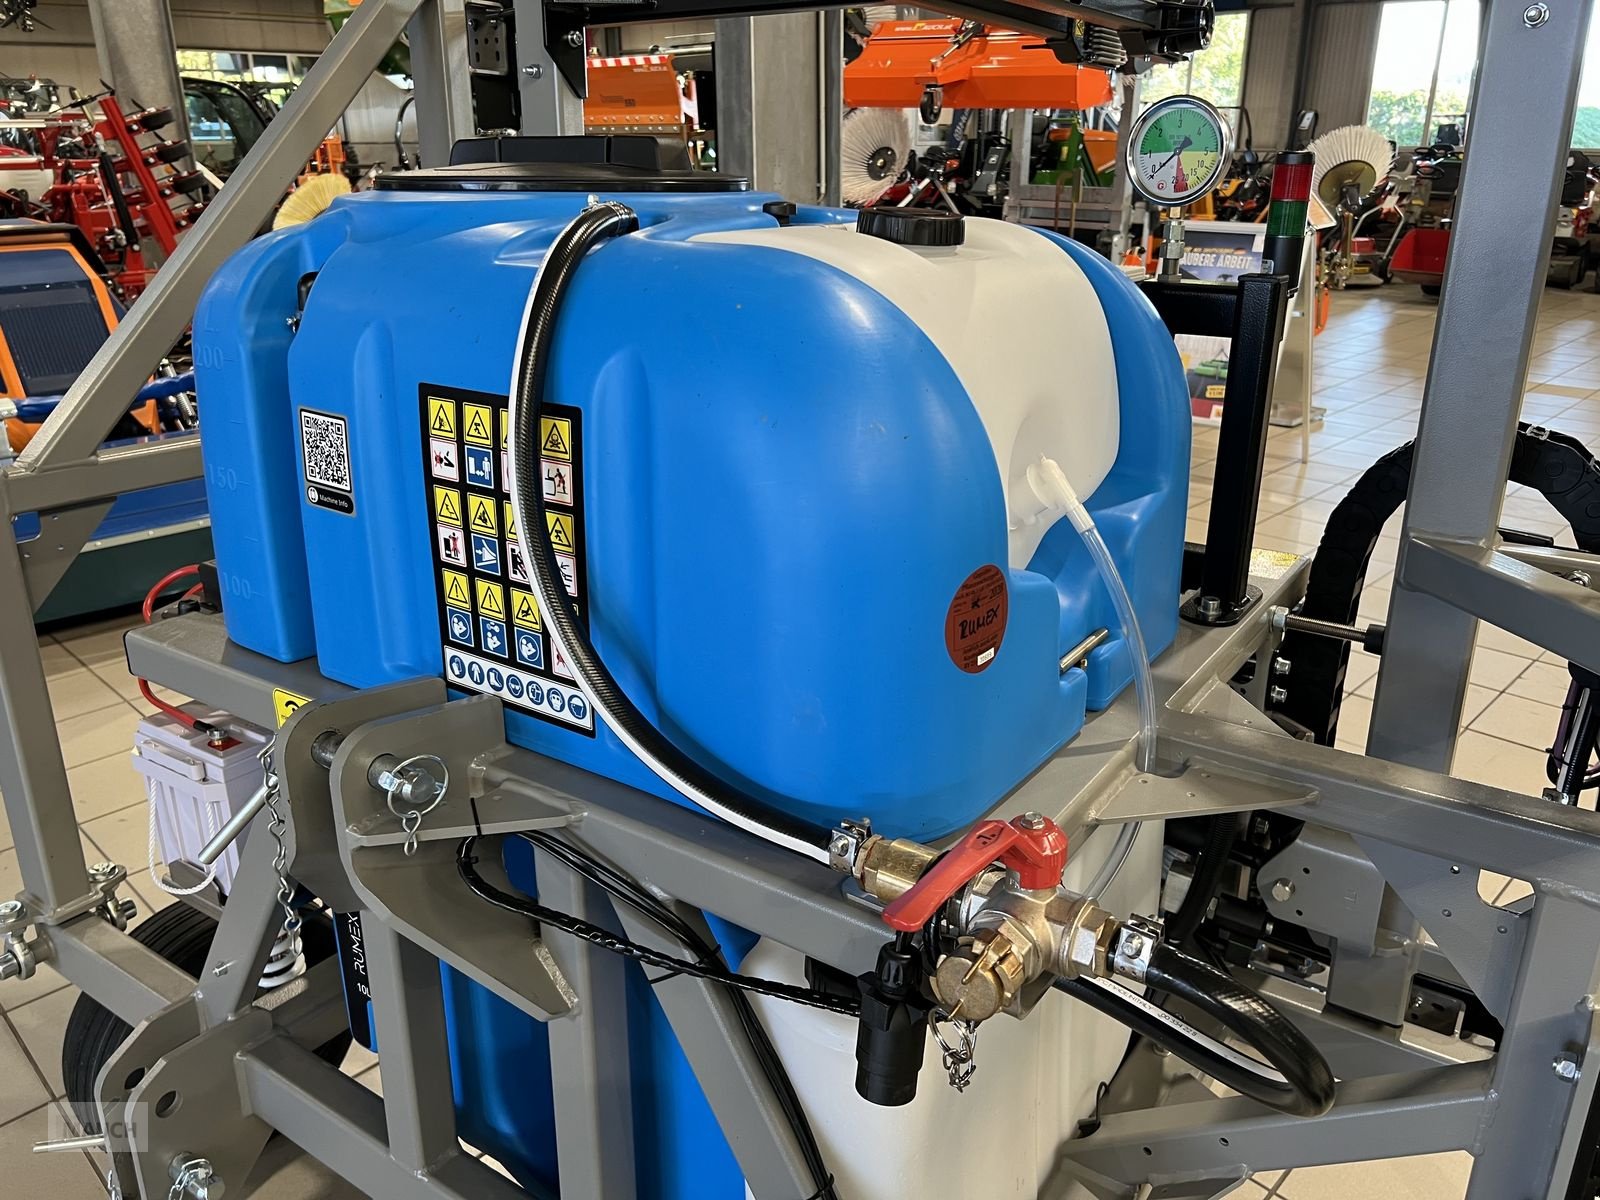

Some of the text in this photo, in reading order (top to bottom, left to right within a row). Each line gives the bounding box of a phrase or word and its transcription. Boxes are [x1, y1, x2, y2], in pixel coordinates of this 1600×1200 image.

[1158, 129, 1163, 138] 2
[1203, 147, 1209, 156] 5
[1197, 160, 1205, 168] 10
[1190, 168, 1198, 176] 15
[1179, 252, 1217, 267] AUBERE
[1216, 254, 1254, 270] ARBEIT
[207, 463, 237, 491] 150
[319, 494, 338, 506] Machine
[222, 571, 250, 599] 100
[347, 912, 366, 975] RUMEX
